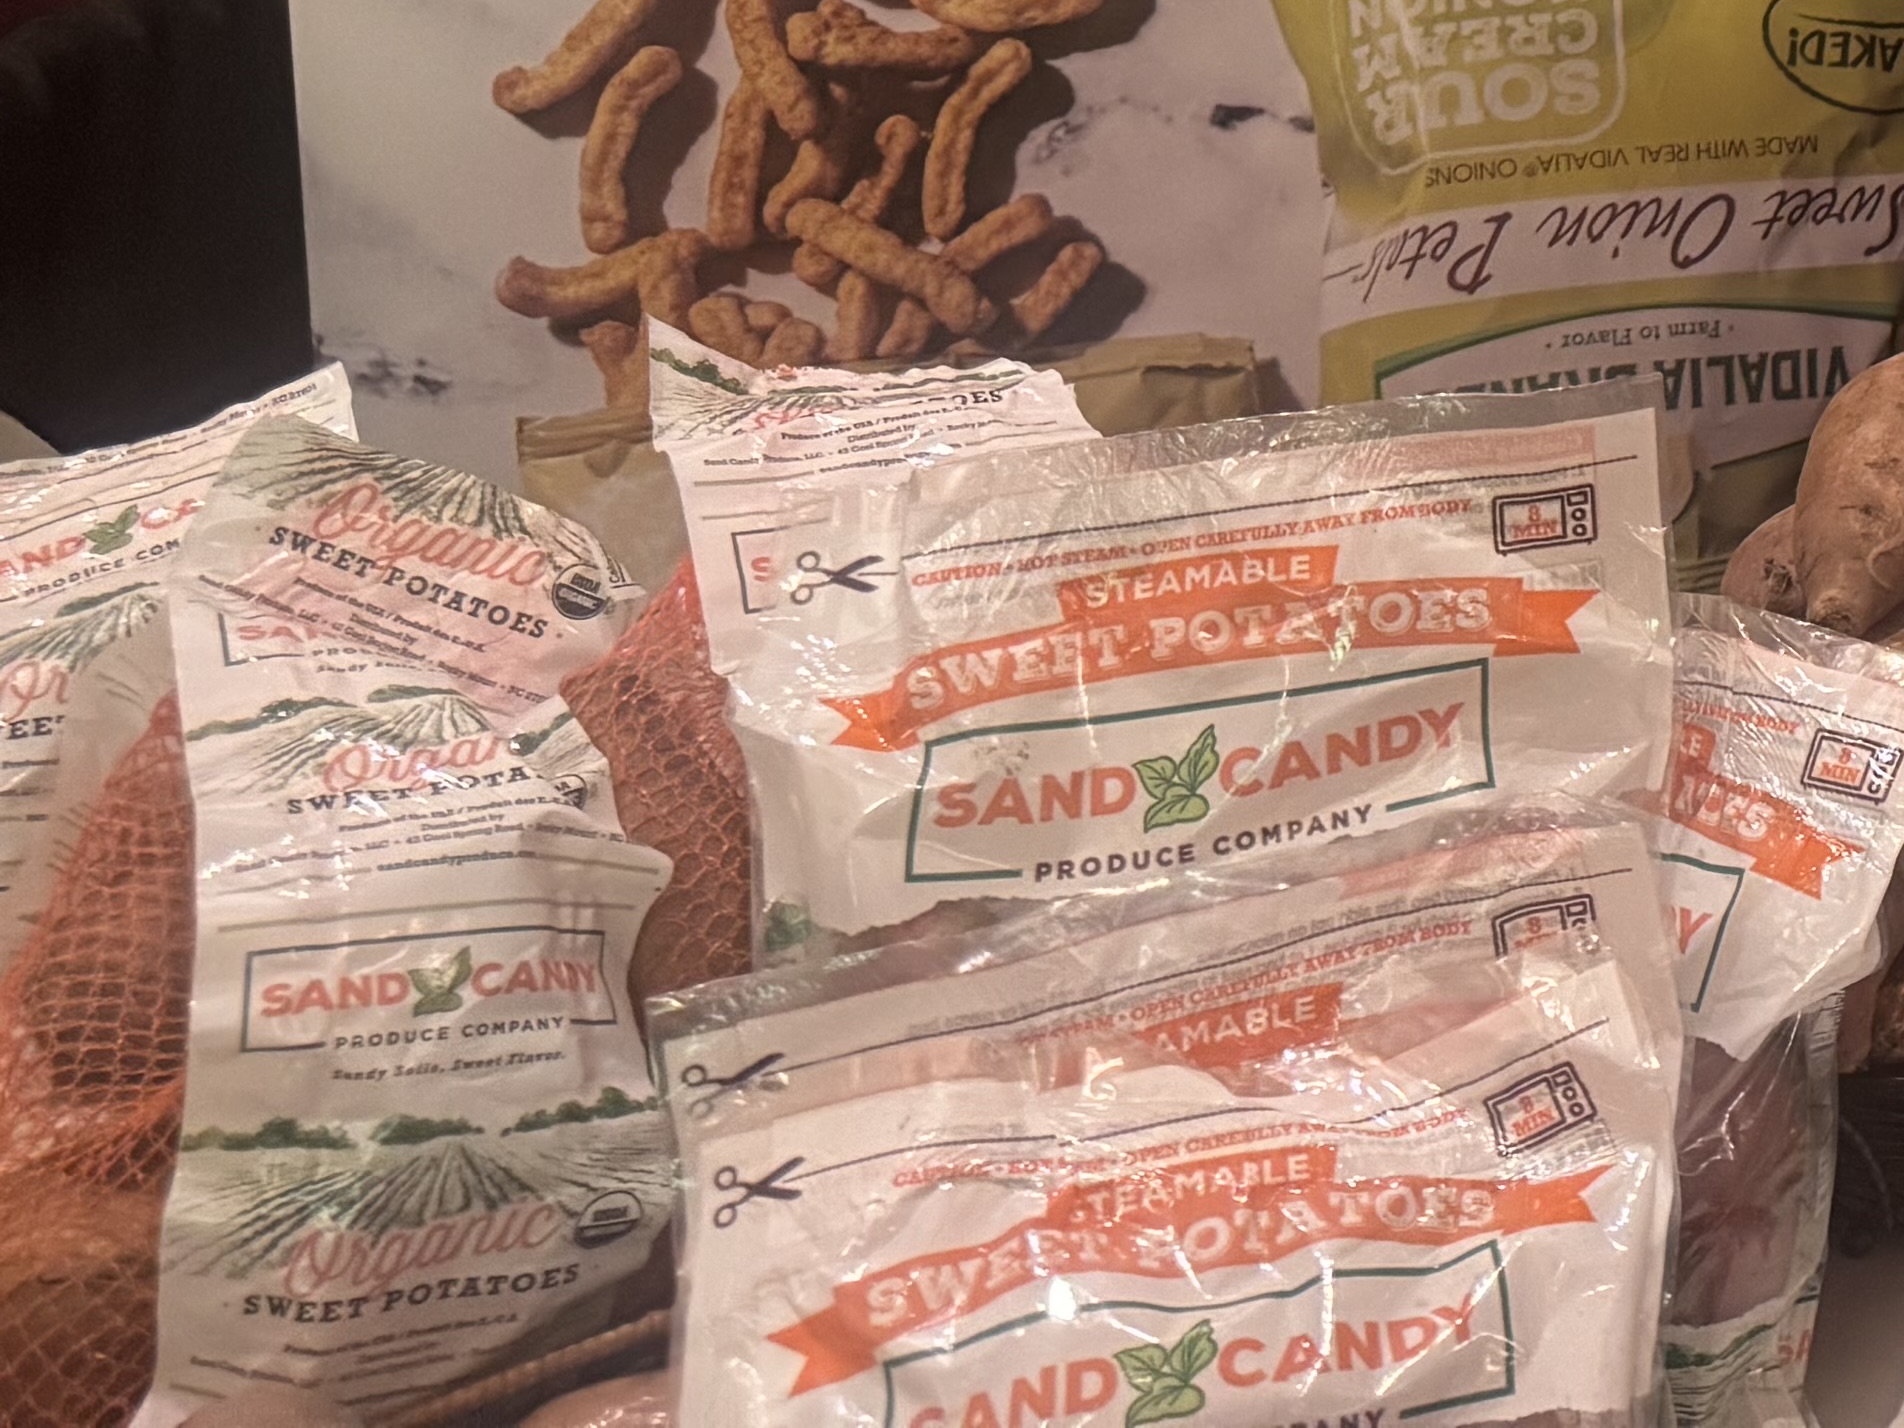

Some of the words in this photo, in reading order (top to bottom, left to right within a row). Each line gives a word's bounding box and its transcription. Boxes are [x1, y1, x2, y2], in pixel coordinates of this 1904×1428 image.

[1353, 8, 1599, 93] CREAM
[1367, 58, 1600, 146] SOUR
[1425, 158, 1517, 188] ONIONS
[1635, 143, 1689, 164] REAL
[1697, 138, 1749, 158] WITH
[1755, 135, 1818, 156] MADE
[1537, 193, 1736, 270] Onion
[1561, 326, 1632, 348] Flavor
[1638, 323, 1662, 340] to
[1669, 320, 1722, 338] Farm
[1662, 347, 1848, 411] VIDALIA
[314, 482, 547, 586] Organic
[1512, 520, 1558, 540] MIN
[269, 526, 380, 578] SWEET
[385, 570, 549, 640] POTATOES
[1084, 553, 1312, 610] STEAMABLE
[907, 627, 1128, 713] SWEET
[1150, 586, 1494, 665] POTATOES
[932, 762, 1137, 831] SAND
[1218, 700, 1466, 798] CANDY
[1034, 843, 1197, 884] PRODUCE
[1211, 803, 1374, 856] COMPANY
[259, 971, 409, 1019] SAND
[334, 1026, 449, 1051] PRODUCE
[461, 1016, 565, 1039] COMPANY
[283, 1196, 564, 1301] Organic
[243, 1294, 369, 1323] SWEET
[382, 1263, 581, 1314] POTATOES
[1218, 1293, 1476, 1389] CANDY
